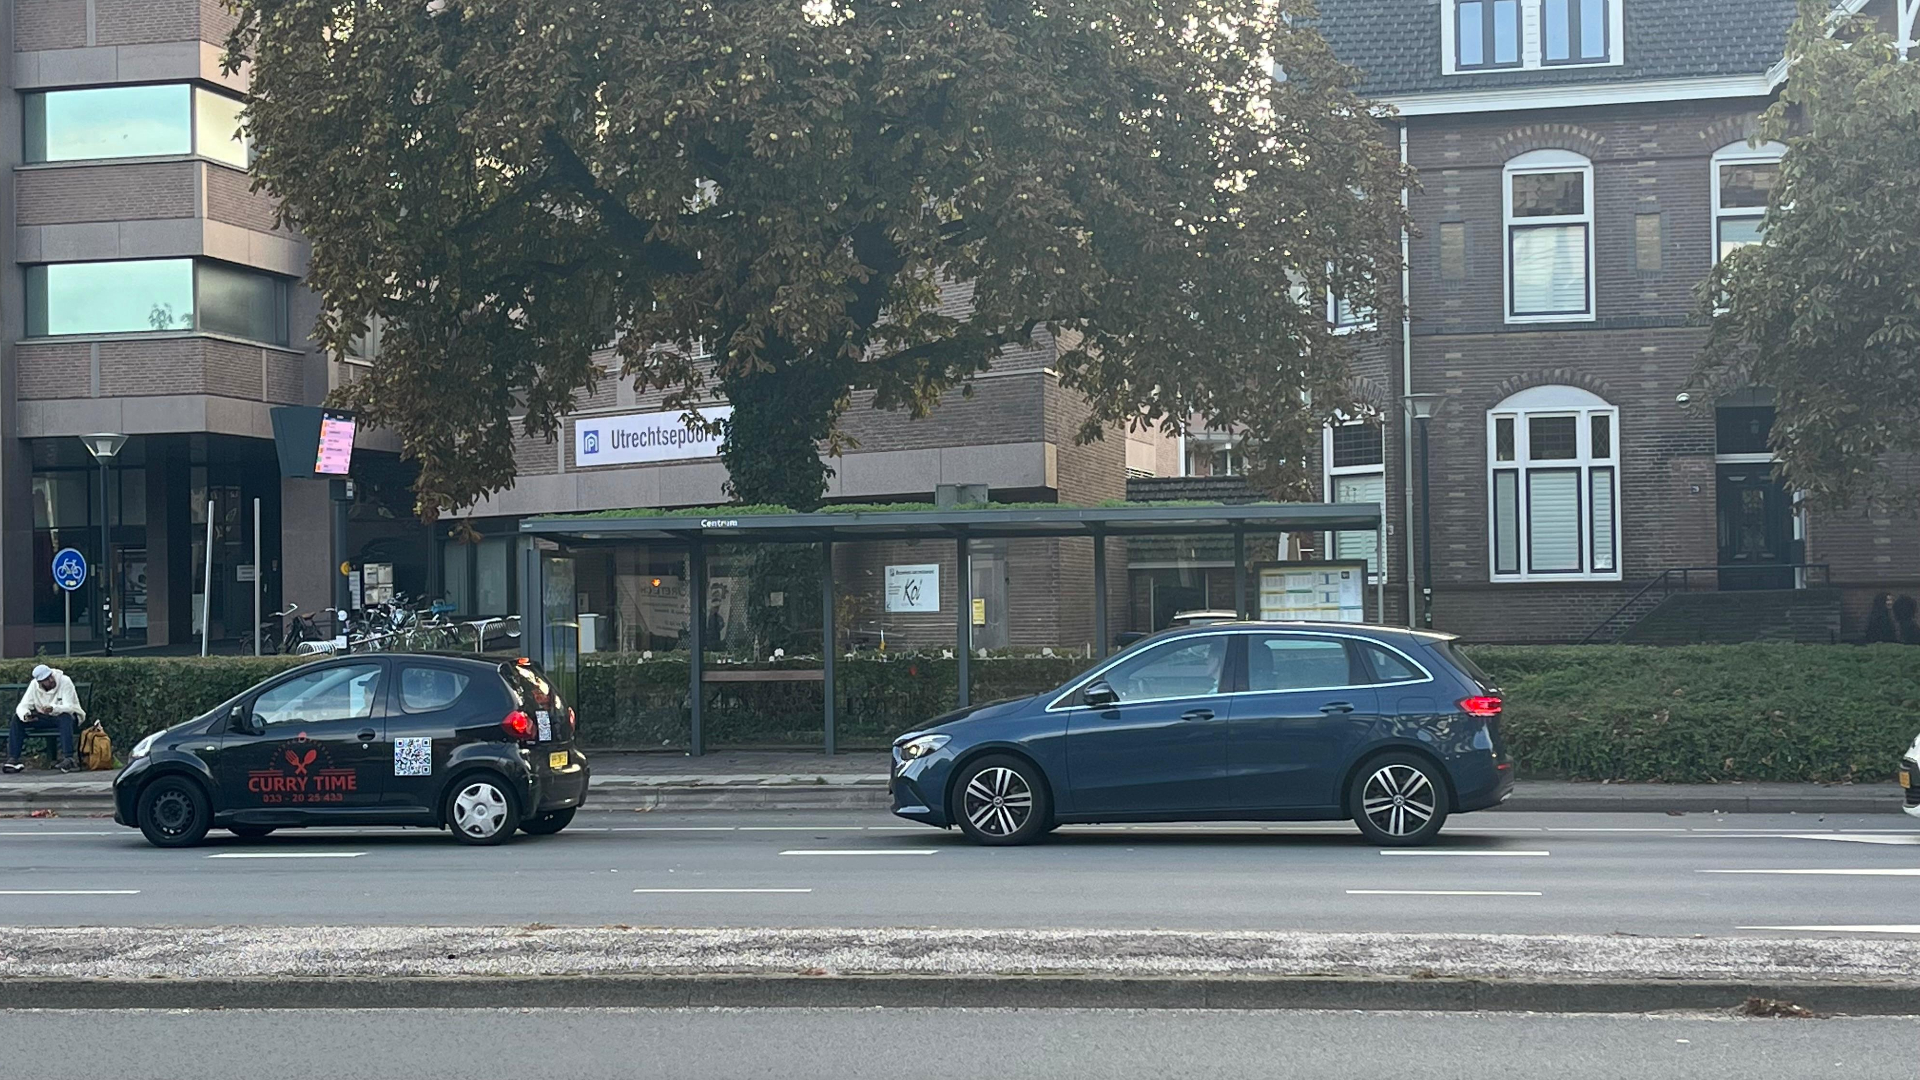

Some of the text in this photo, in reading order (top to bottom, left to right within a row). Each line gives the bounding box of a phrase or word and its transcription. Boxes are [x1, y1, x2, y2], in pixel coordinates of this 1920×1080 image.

[700, 519, 738, 528] Centrum
[248, 775, 357, 792] CURRY TIME
[263, 794, 282, 803] 033
[292, 793, 304, 802] 20
[307, 793, 320, 802] 25
